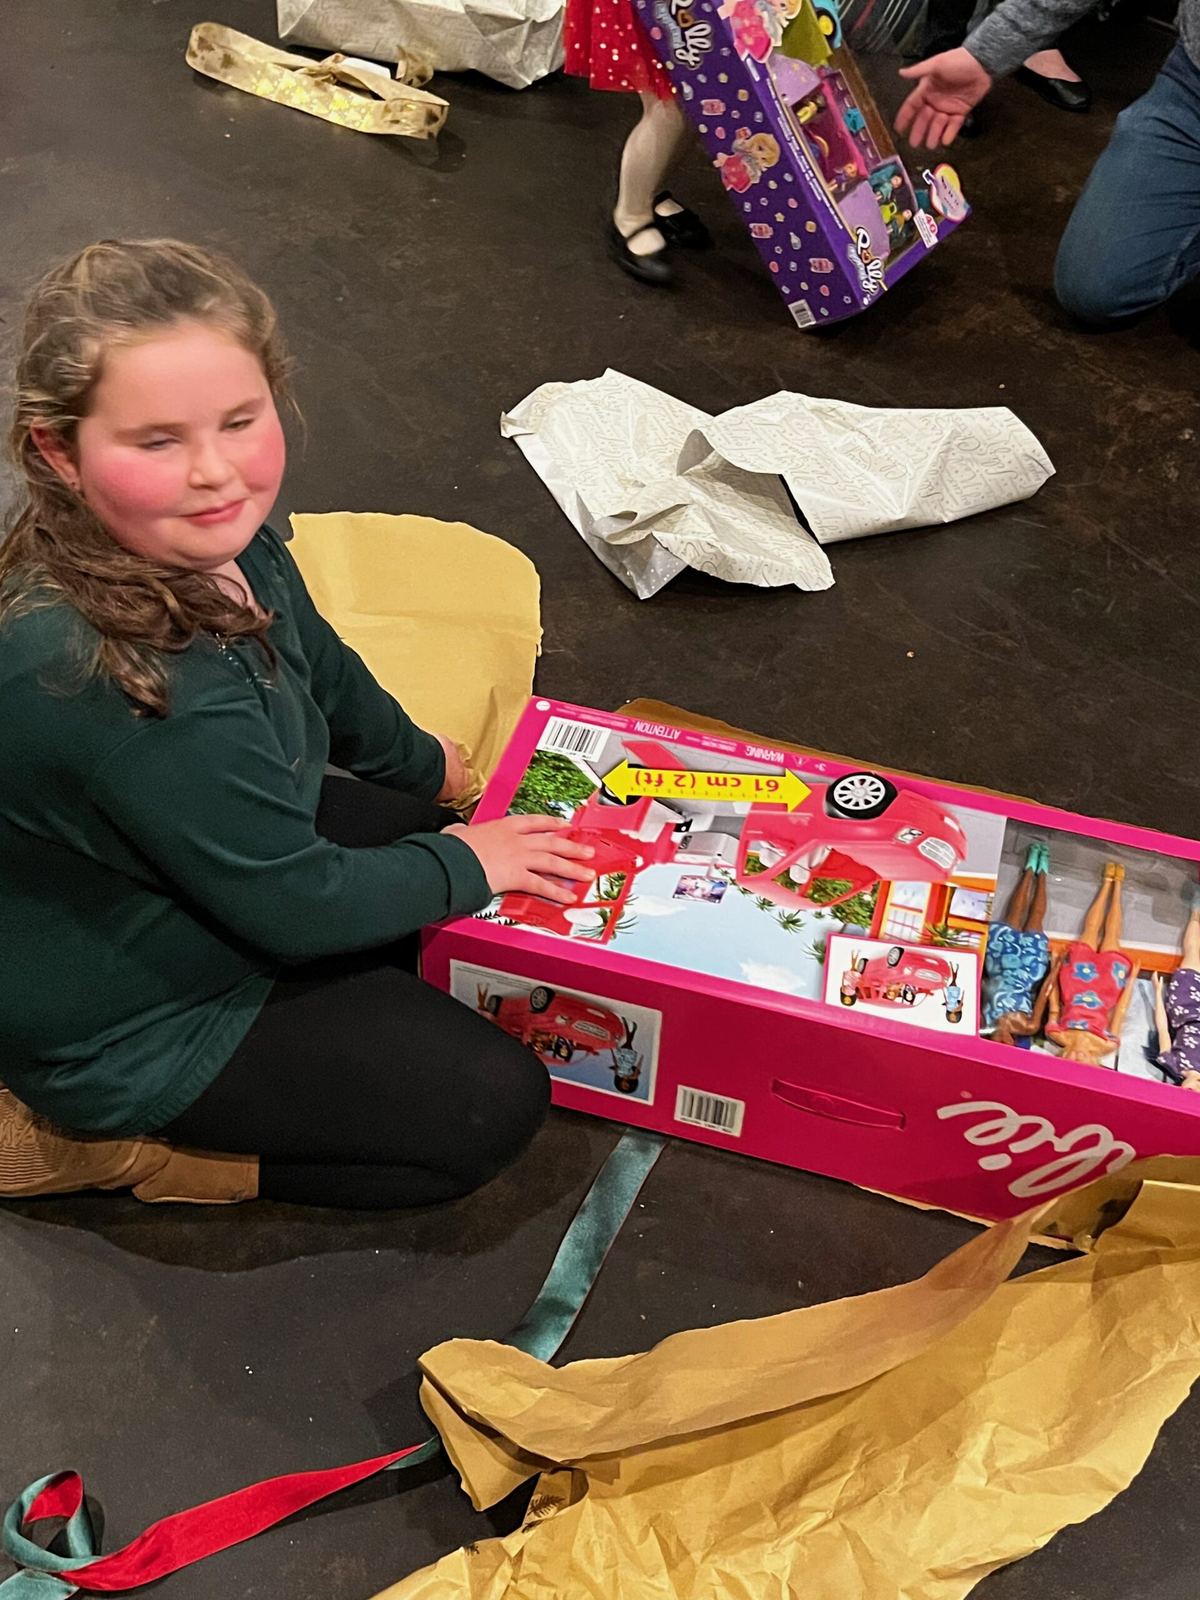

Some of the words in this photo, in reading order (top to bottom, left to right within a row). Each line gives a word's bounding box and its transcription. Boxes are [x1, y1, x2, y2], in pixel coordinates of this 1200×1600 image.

[856, 227, 883, 293] Polly
[634, 721, 681, 740] ATTENTION
[634, 771, 663, 786] ft)
[673, 773, 696, 789] (2
[706, 776, 741, 788] cm
[754, 779, 779, 792] 61
